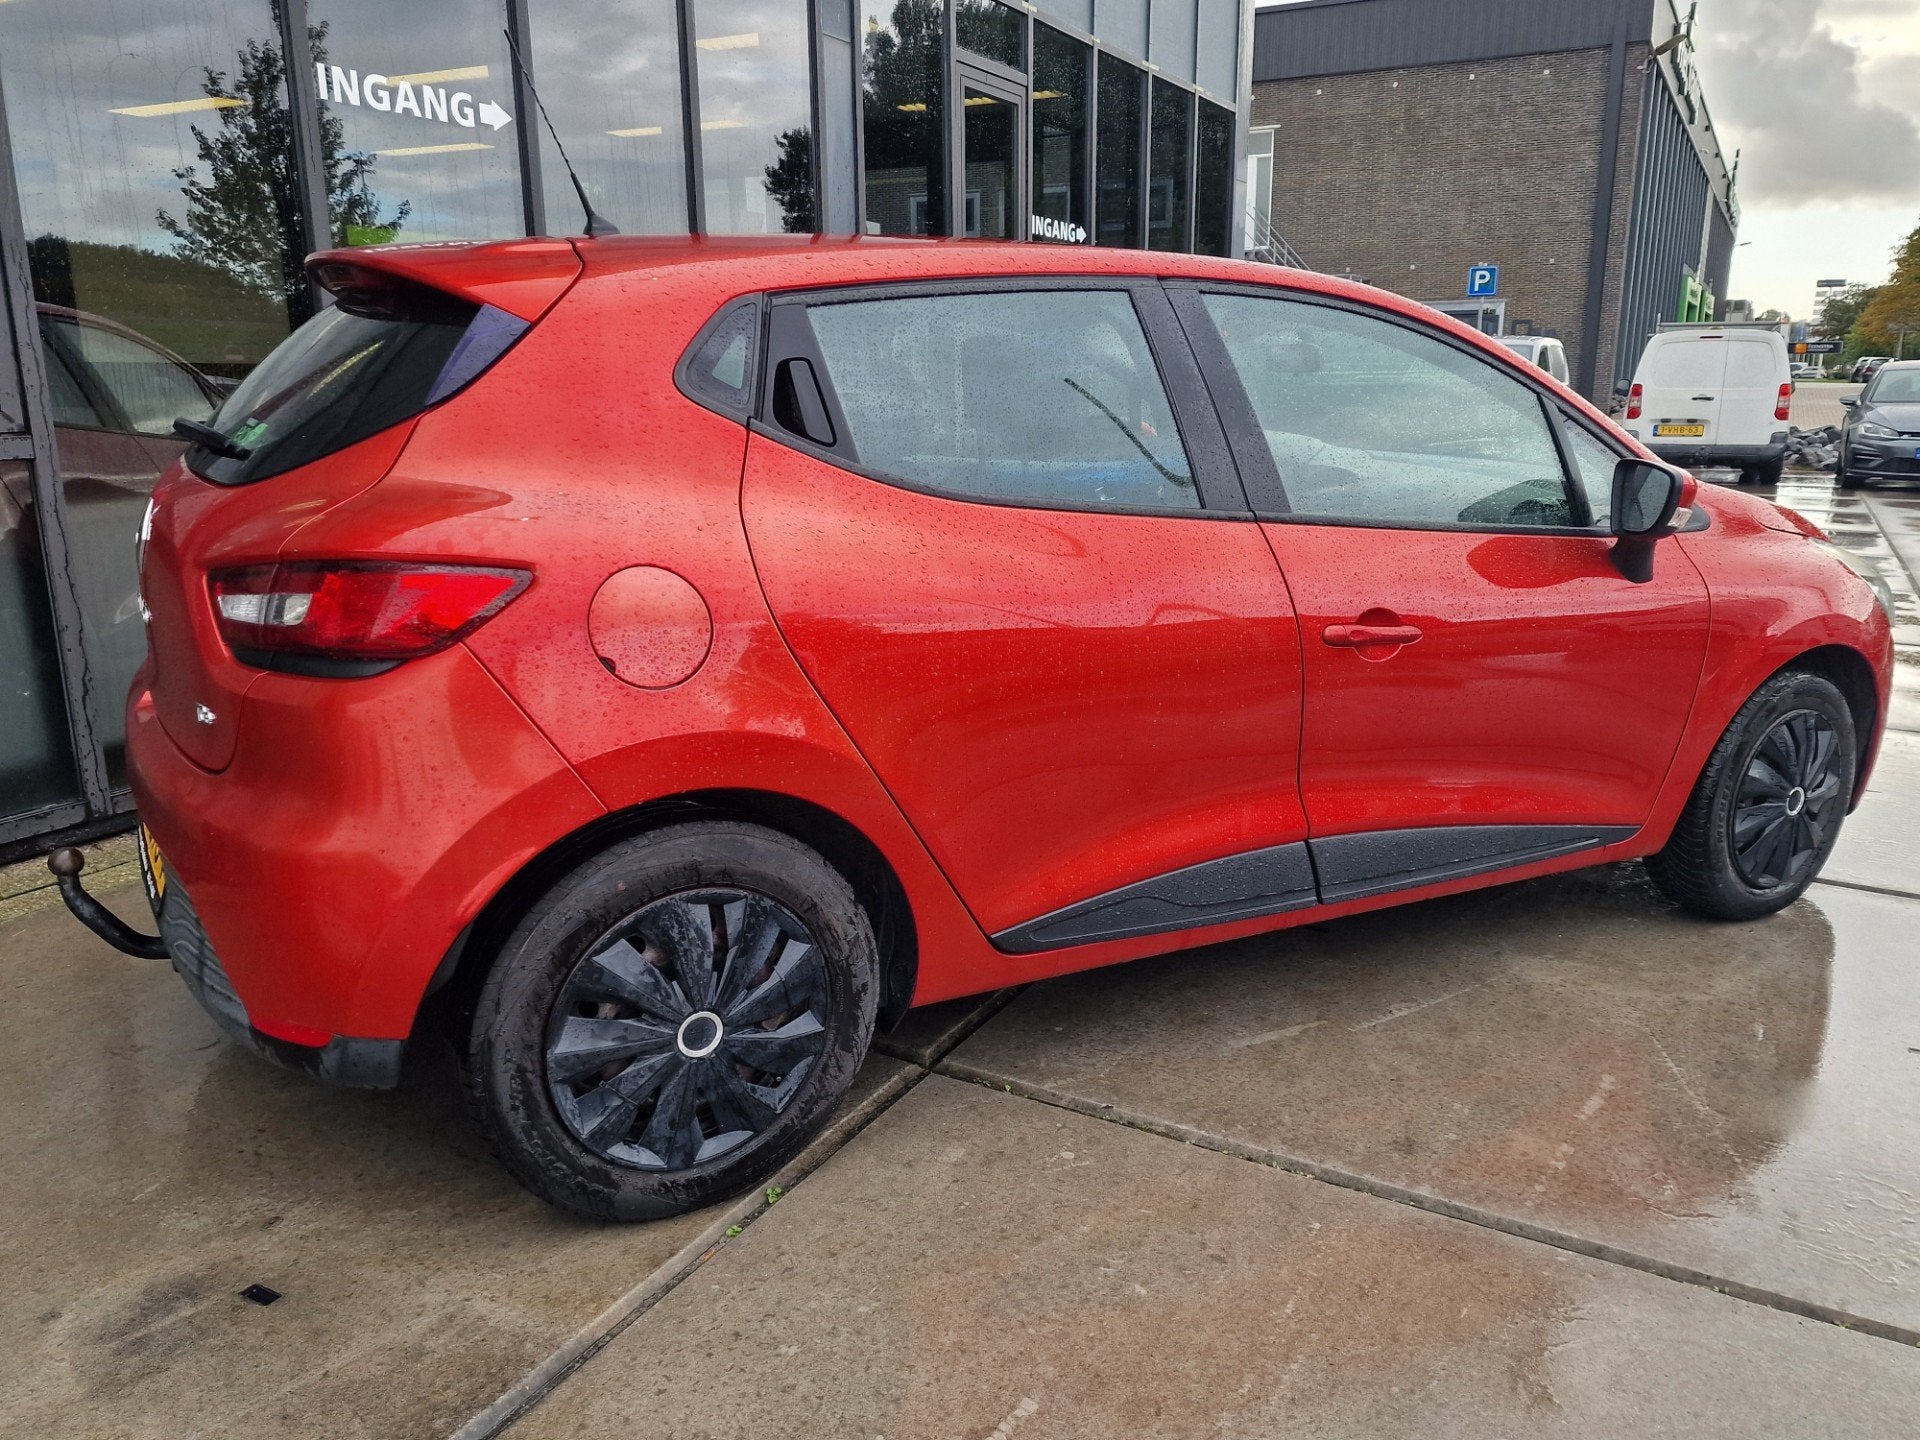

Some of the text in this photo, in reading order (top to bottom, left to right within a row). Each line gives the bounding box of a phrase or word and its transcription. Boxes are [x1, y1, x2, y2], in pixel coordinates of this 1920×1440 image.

[316, 62, 476, 128] INGANG
[1031, 214, 1076, 243] INGANG
[1474, 270, 1490, 291] P
